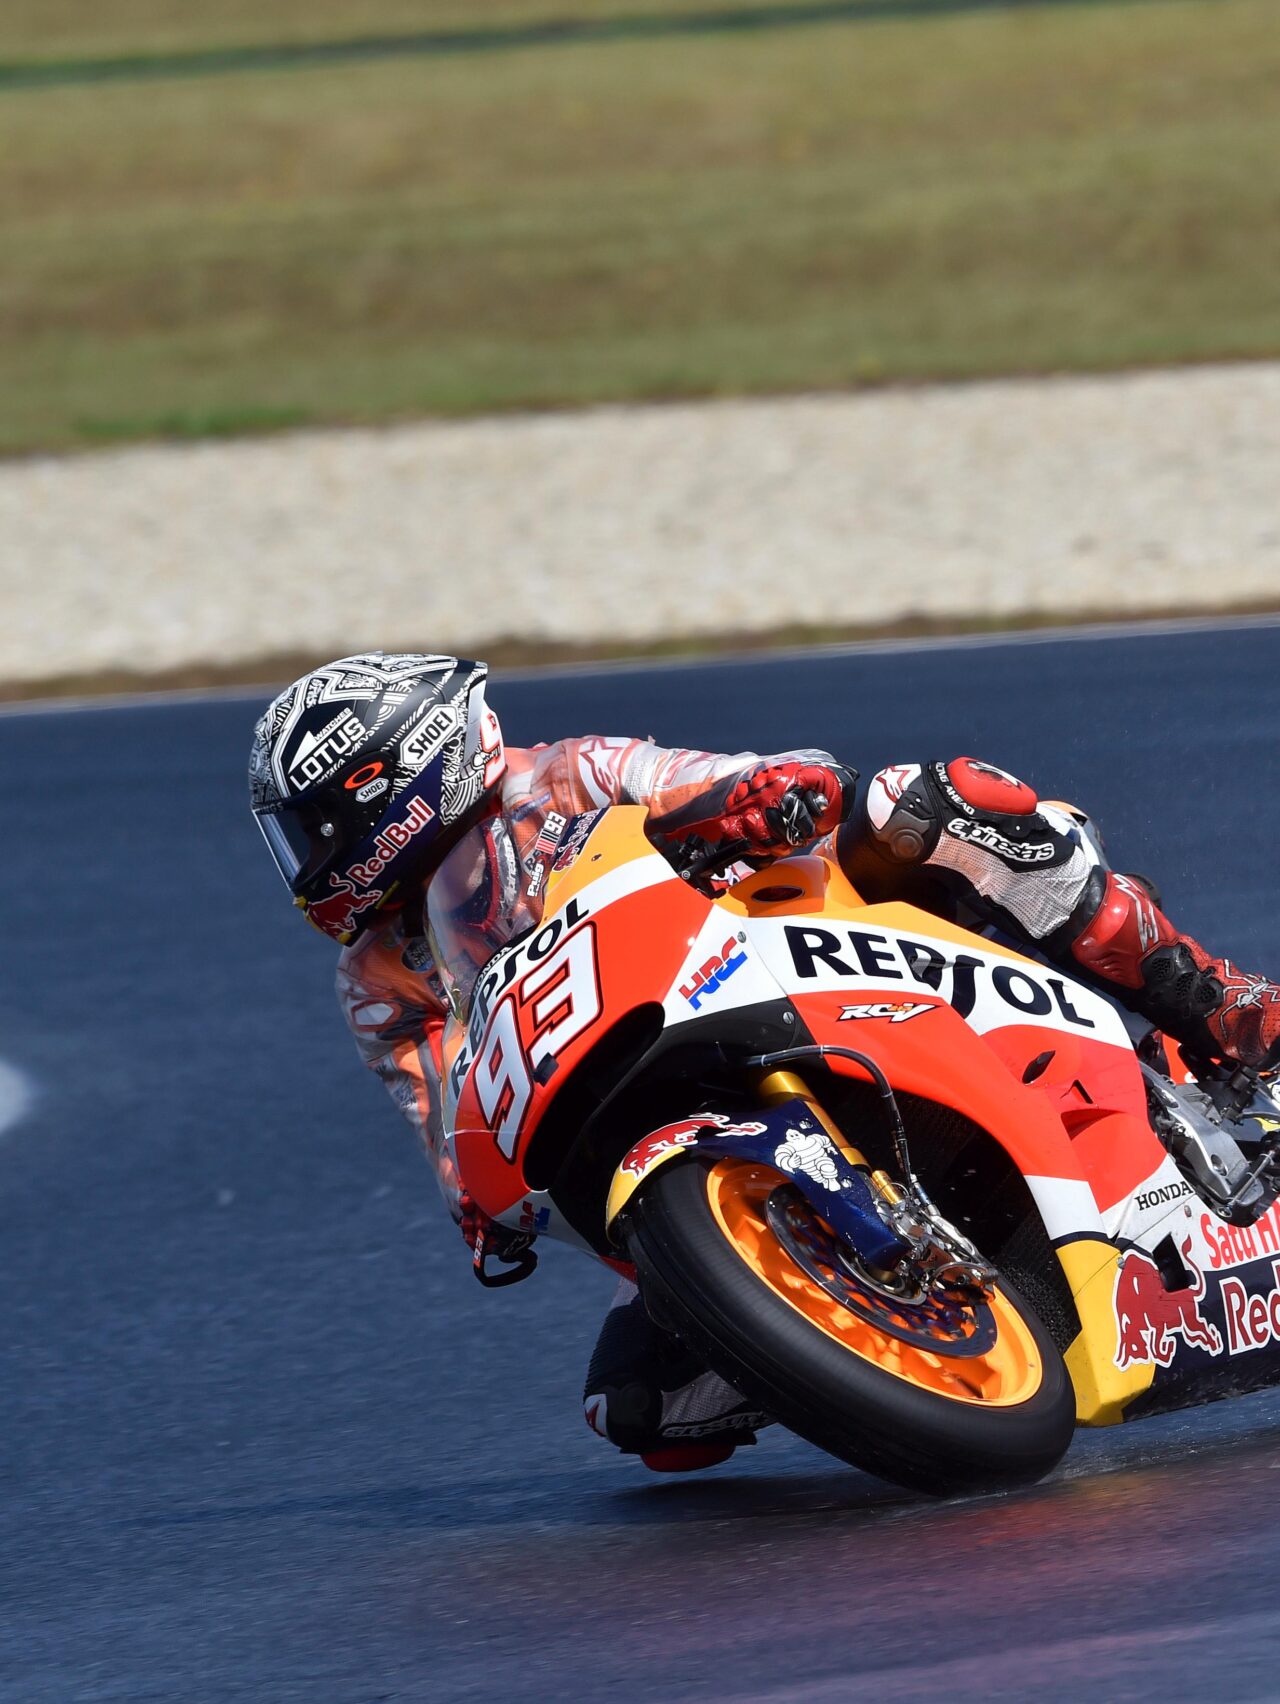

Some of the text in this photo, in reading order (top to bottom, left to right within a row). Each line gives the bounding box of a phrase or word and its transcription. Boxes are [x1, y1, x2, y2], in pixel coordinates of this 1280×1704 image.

[289, 716, 367, 791] LOTUS
[407, 710, 453, 761] SHOEI
[360, 780, 385, 799] SHOEI
[945, 784, 976, 816] AHEAD
[345, 795, 437, 888] Red Bull
[543, 811, 567, 835] 93
[526, 862, 545, 897] Puig
[784, 924, 1096, 1029] REPSOL
[474, 920, 604, 1164] 93
[1135, 1180, 1194, 1211] HONDA
[1200, 1213, 1258, 1269] Satu
